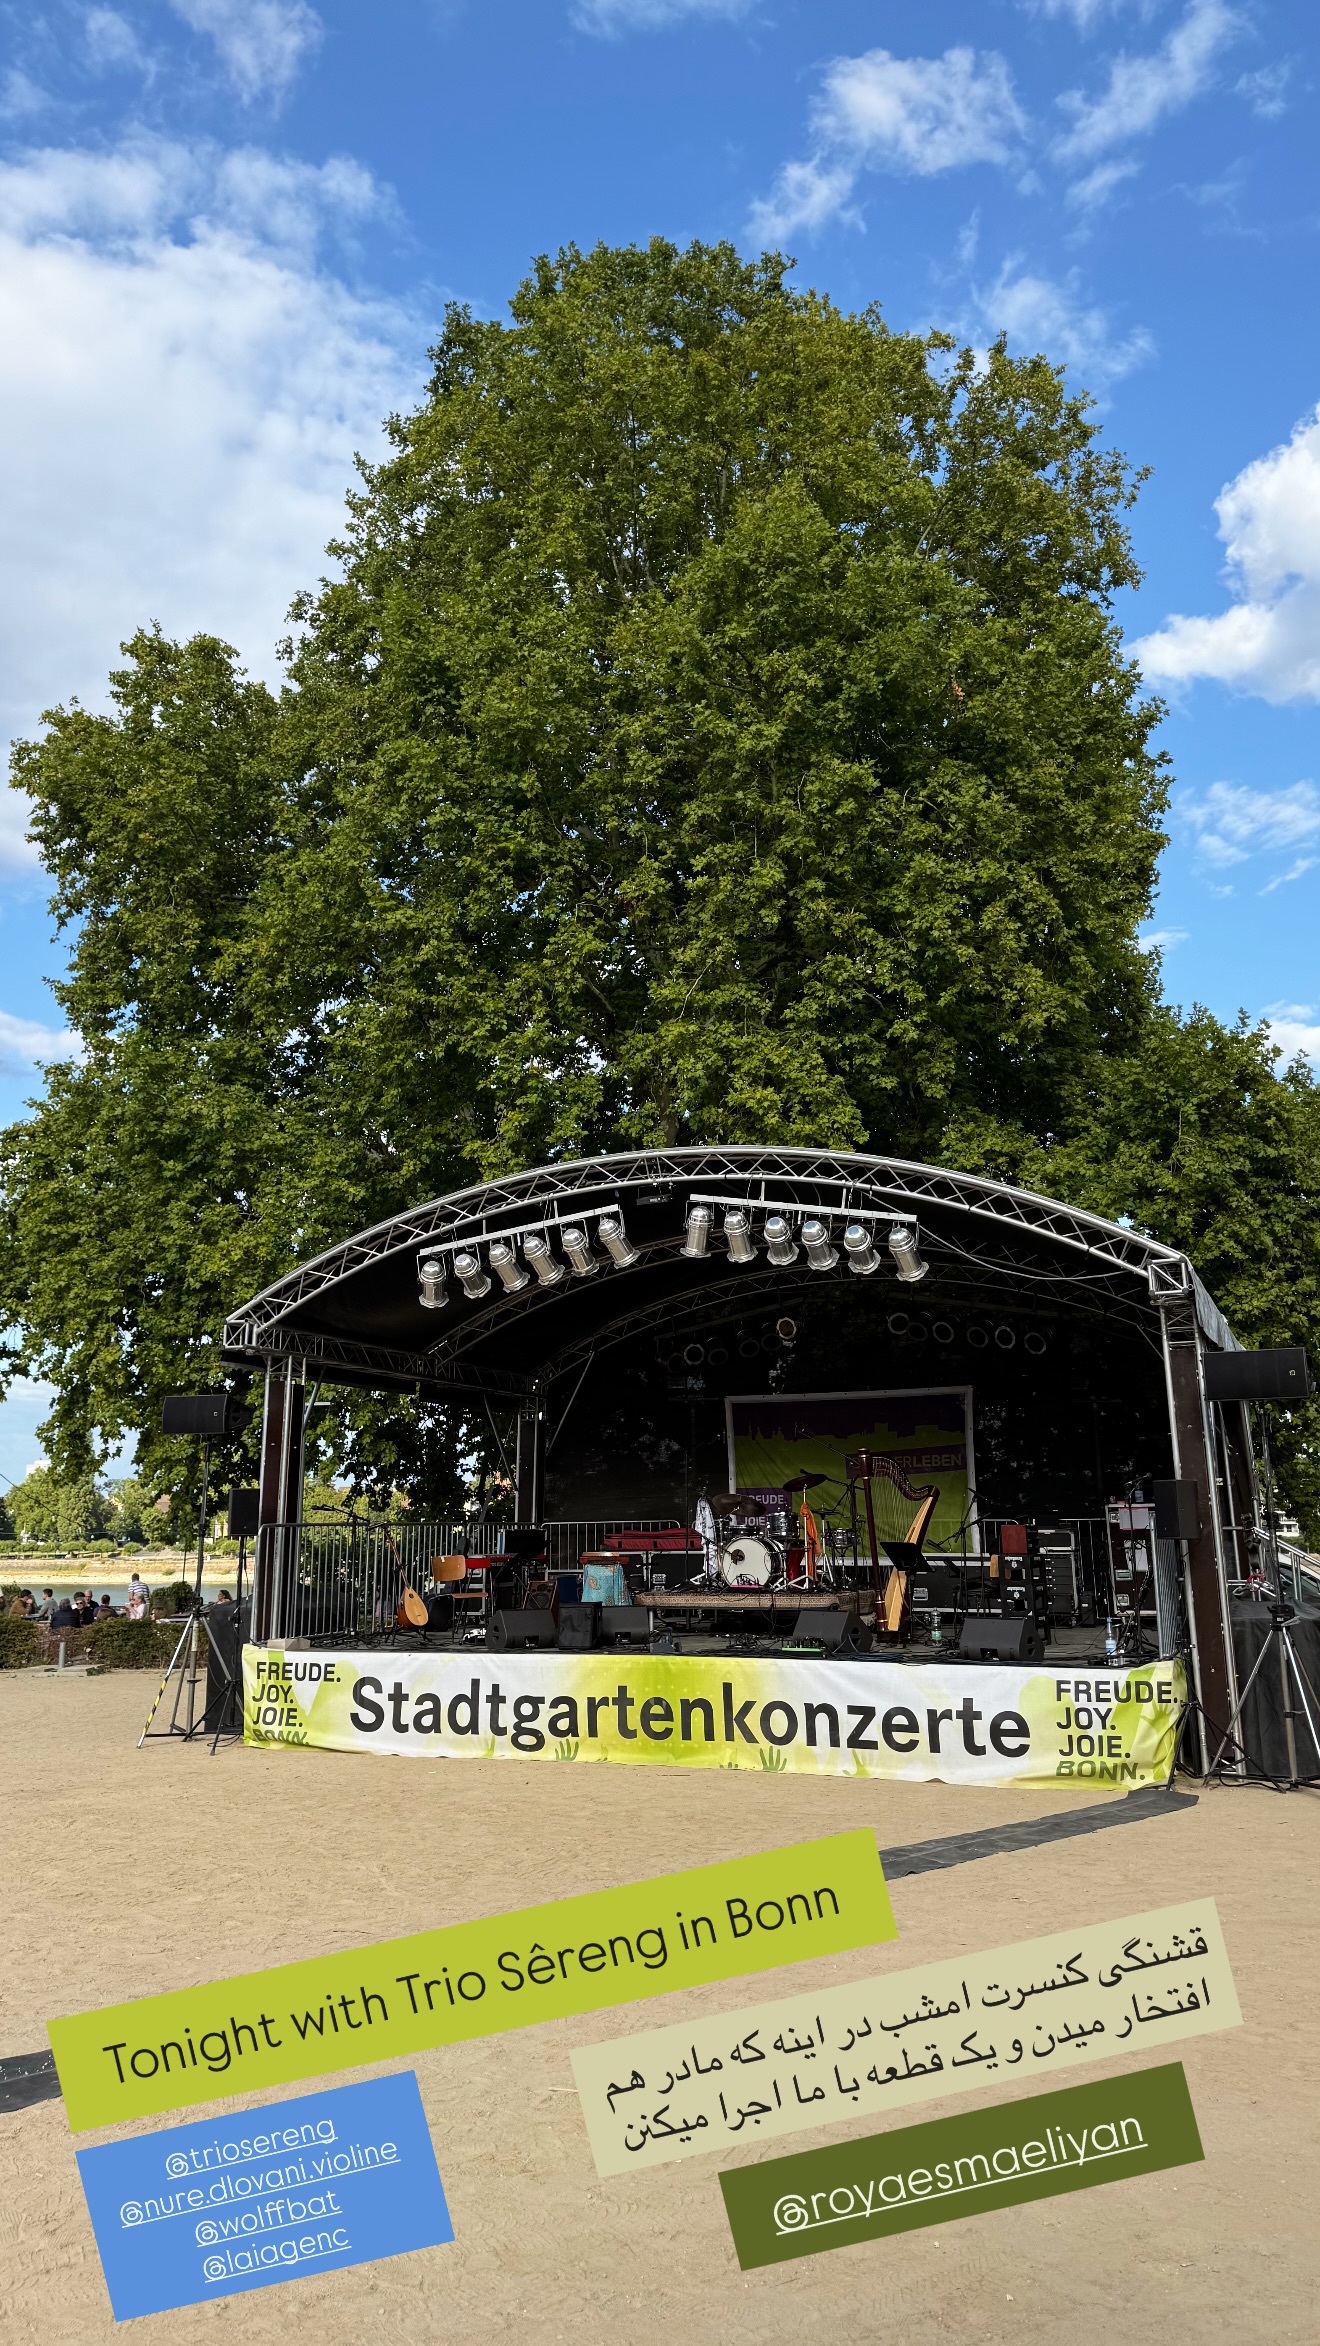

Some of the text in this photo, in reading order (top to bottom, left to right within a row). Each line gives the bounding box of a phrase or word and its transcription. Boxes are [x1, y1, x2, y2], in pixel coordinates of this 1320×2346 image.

[255, 1661, 341, 1683] FREUDE.
[251, 1683, 294, 1704] JOY.
[1055, 1679, 1178, 1704] FREUDE.
[251, 1706, 303, 1728] JOIE.
[349, 1676, 1031, 1758] Stadtgartenkonzerte
[1056, 1706, 1117, 1731] JOY.
[1058, 1734, 1131, 1759] JOIE.
[1055, 1760, 1146, 1781] BONN.
